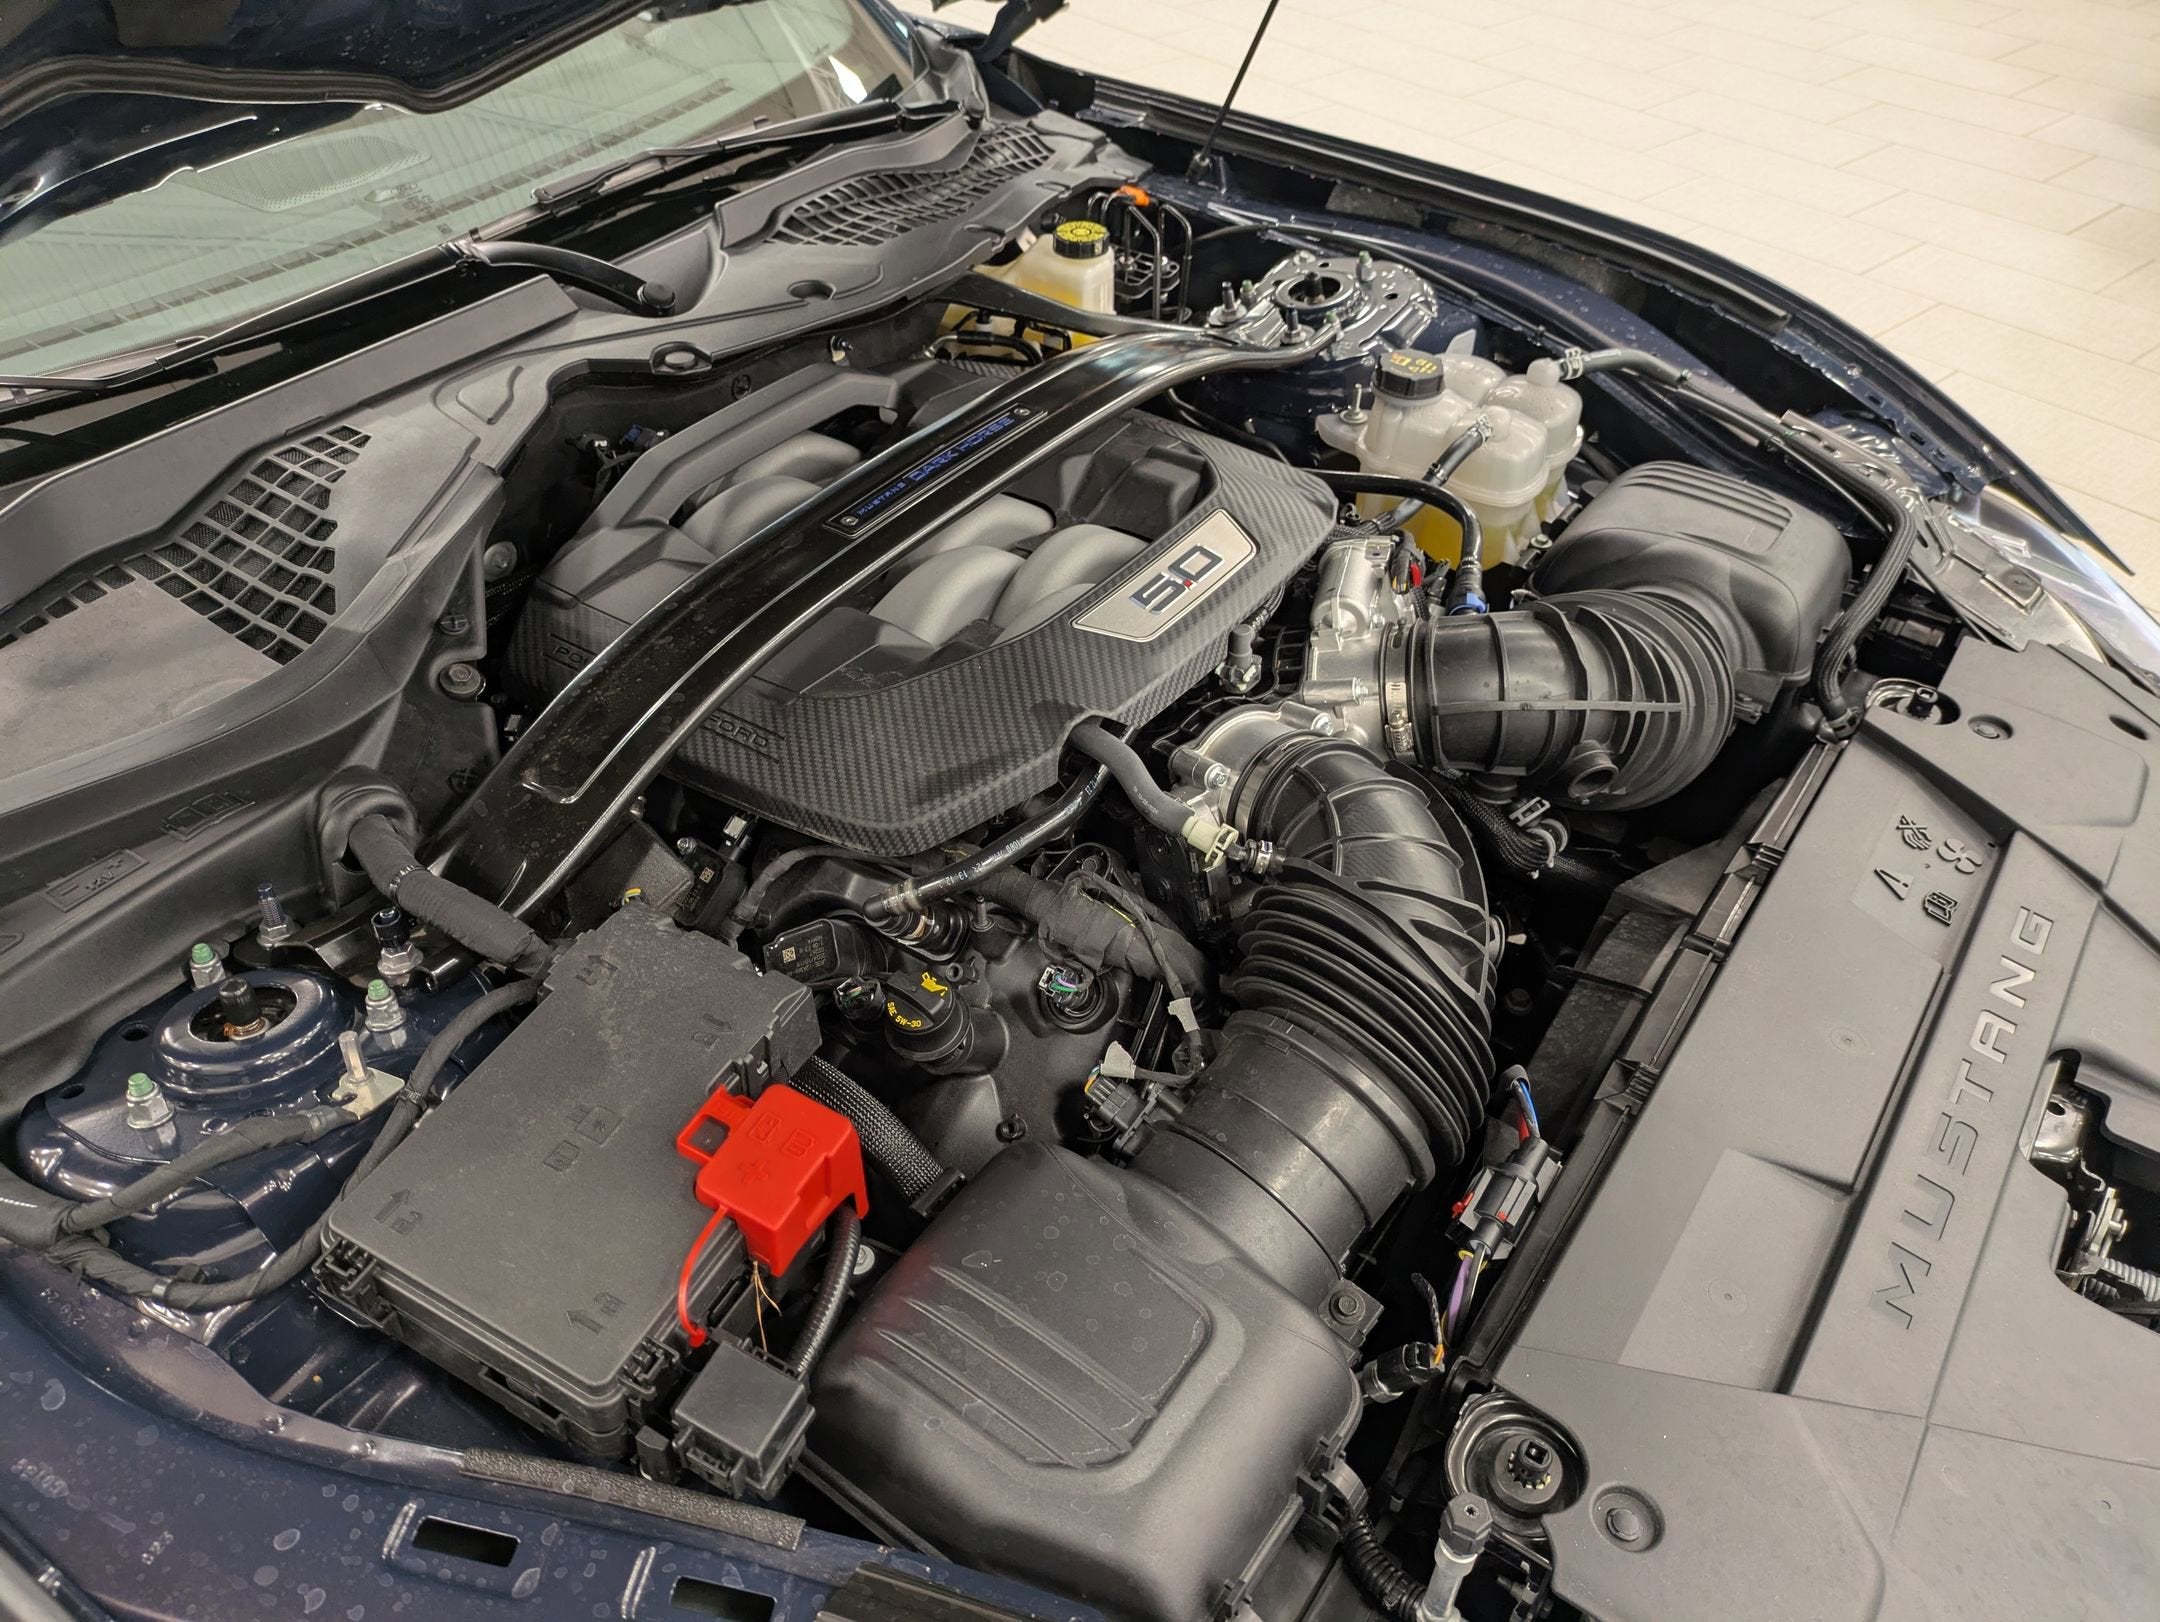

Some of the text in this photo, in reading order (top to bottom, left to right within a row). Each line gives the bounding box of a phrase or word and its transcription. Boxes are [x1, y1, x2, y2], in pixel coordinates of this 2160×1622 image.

[857, 416, 1016, 516] MUSTANG DARK HORSE
[1129, 544, 1224, 615] 5.0
[887, 1001, 922, 1028] SAE 5W-30
[1868, 905, 2055, 1330] MUSTANG
